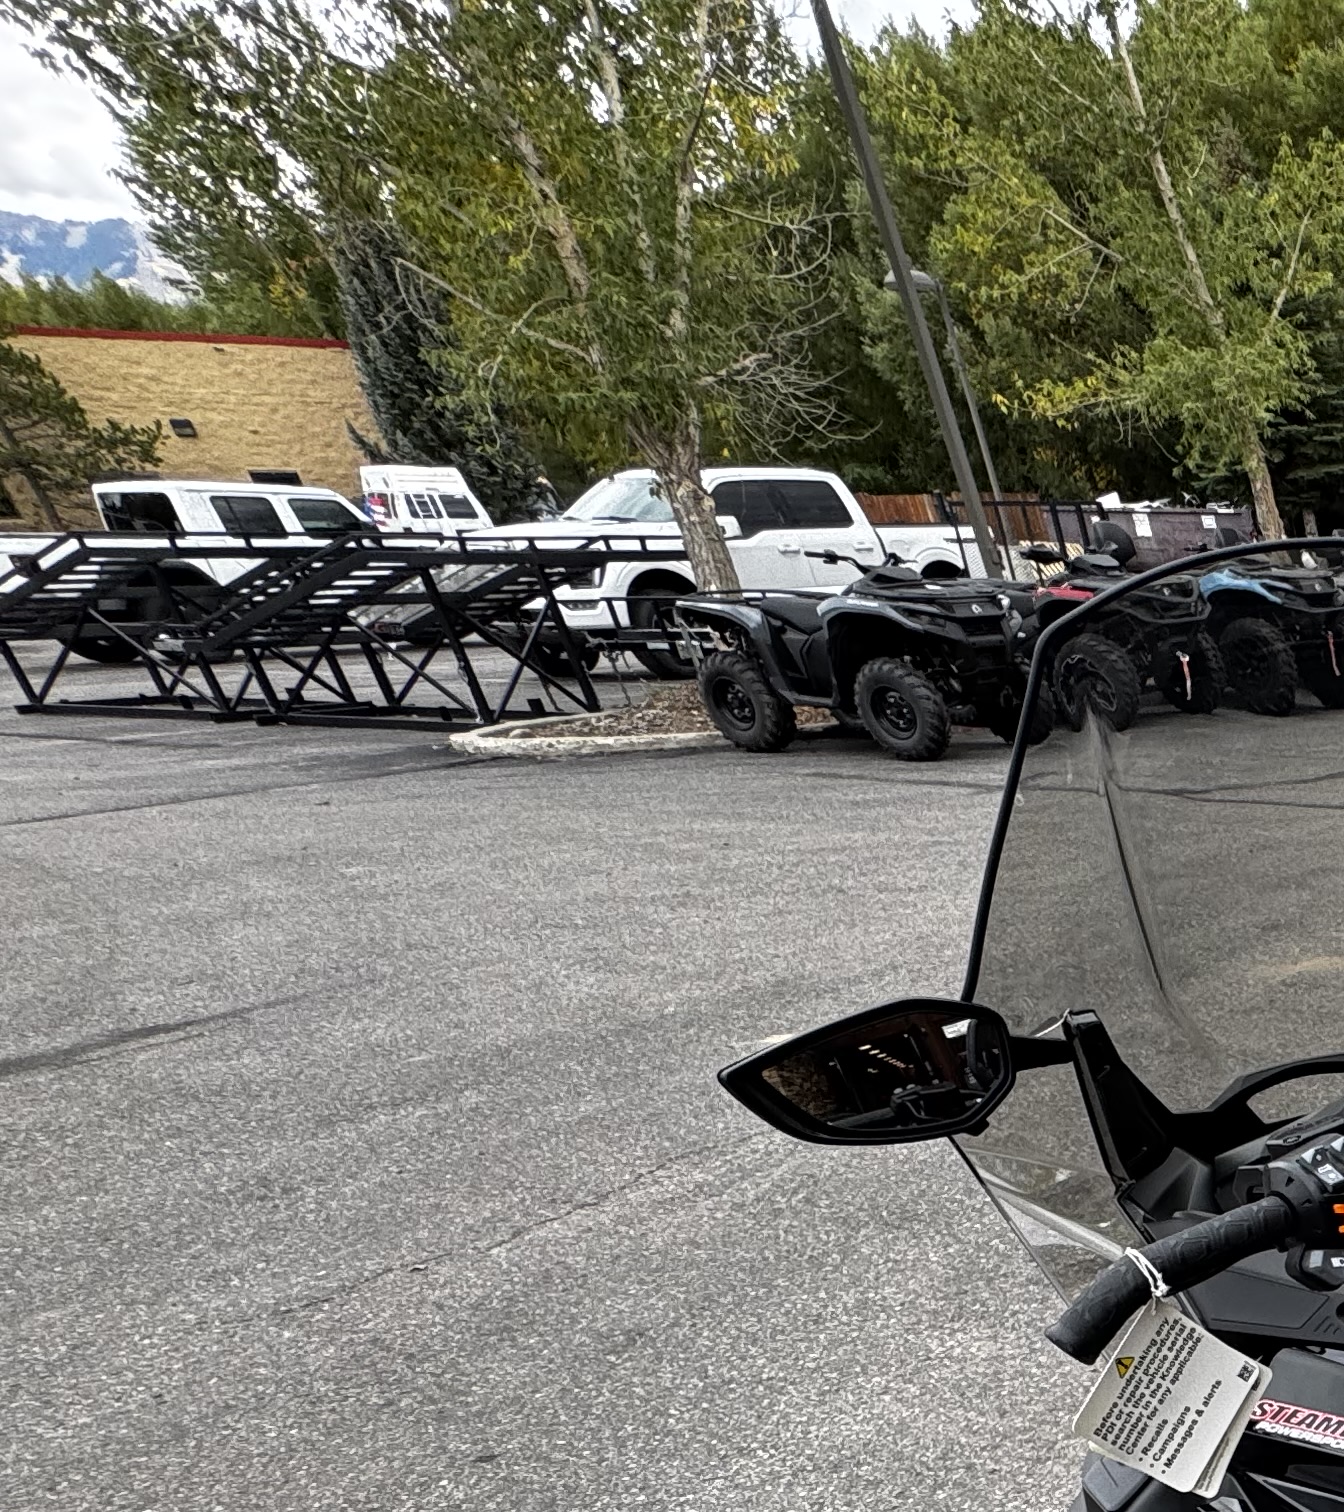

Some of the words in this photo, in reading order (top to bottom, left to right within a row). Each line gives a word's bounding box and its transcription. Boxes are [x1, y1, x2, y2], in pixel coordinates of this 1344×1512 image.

[1093, 1401, 1118, 1437] Before
[1116, 1338, 1157, 1400] undertaking
[1155, 1316, 1169, 1337] any
[1101, 1421, 1117, 1442] PDI
[1115, 1409, 1124, 1421] or
[1123, 1376, 1144, 1407] repair
[1110, 1411, 1135, 1446] search
[1132, 1392, 1146, 1408] the
[1144, 1354, 1168, 1389] vehicle
[1167, 1323, 1186, 1353] serial
[1118, 1411, 1144, 1451] number
[1141, 1400, 1152, 1410] in
[1149, 1383, 1162, 1399] the
[1159, 1327, 1196, 1381] Knowledge
[1125, 1421, 1149, 1455] Center
[1146, 1406, 1159, 1421] for
[1157, 1386, 1171, 1405] any
[1141, 1419, 1168, 1456] Recalls
[1153, 1406, 1190, 1461] Campaigns
[1164, 1419, 1198, 1468] Messages
[1195, 1409, 1204, 1417] &
[1202, 1380, 1221, 1407] alerts
